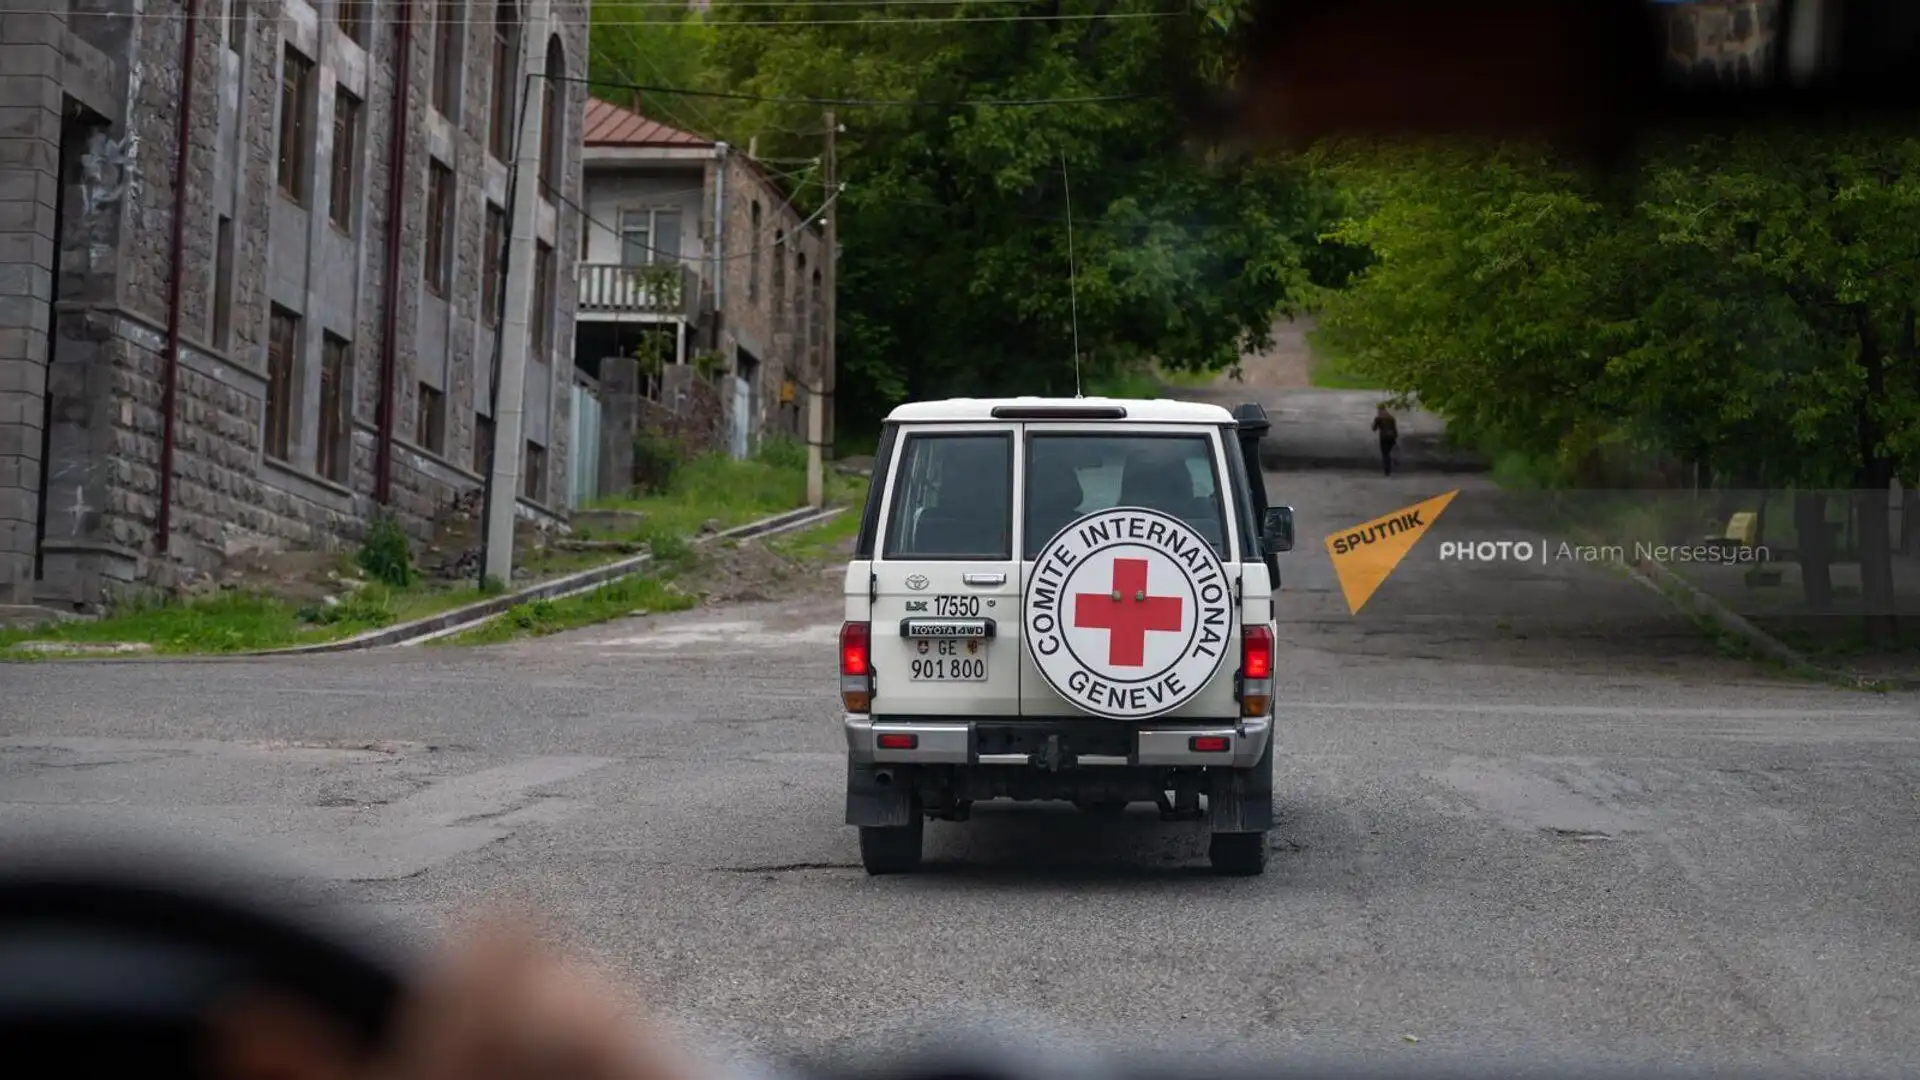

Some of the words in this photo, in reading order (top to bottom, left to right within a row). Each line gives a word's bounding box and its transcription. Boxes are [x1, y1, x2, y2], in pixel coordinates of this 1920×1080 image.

[1032, 544, 1077, 656] COMITE
[1079, 517, 1224, 659] INTERNATIONAL
[934, 595, 980, 616] 17550
[914, 625, 955, 635] TOYOTA
[957, 625, 984, 635] 4WD
[938, 640, 957, 655] GE
[911, 659, 945, 678] 901
[950, 659, 984, 678] 800
[1068, 670, 1186, 709] GENEVE
